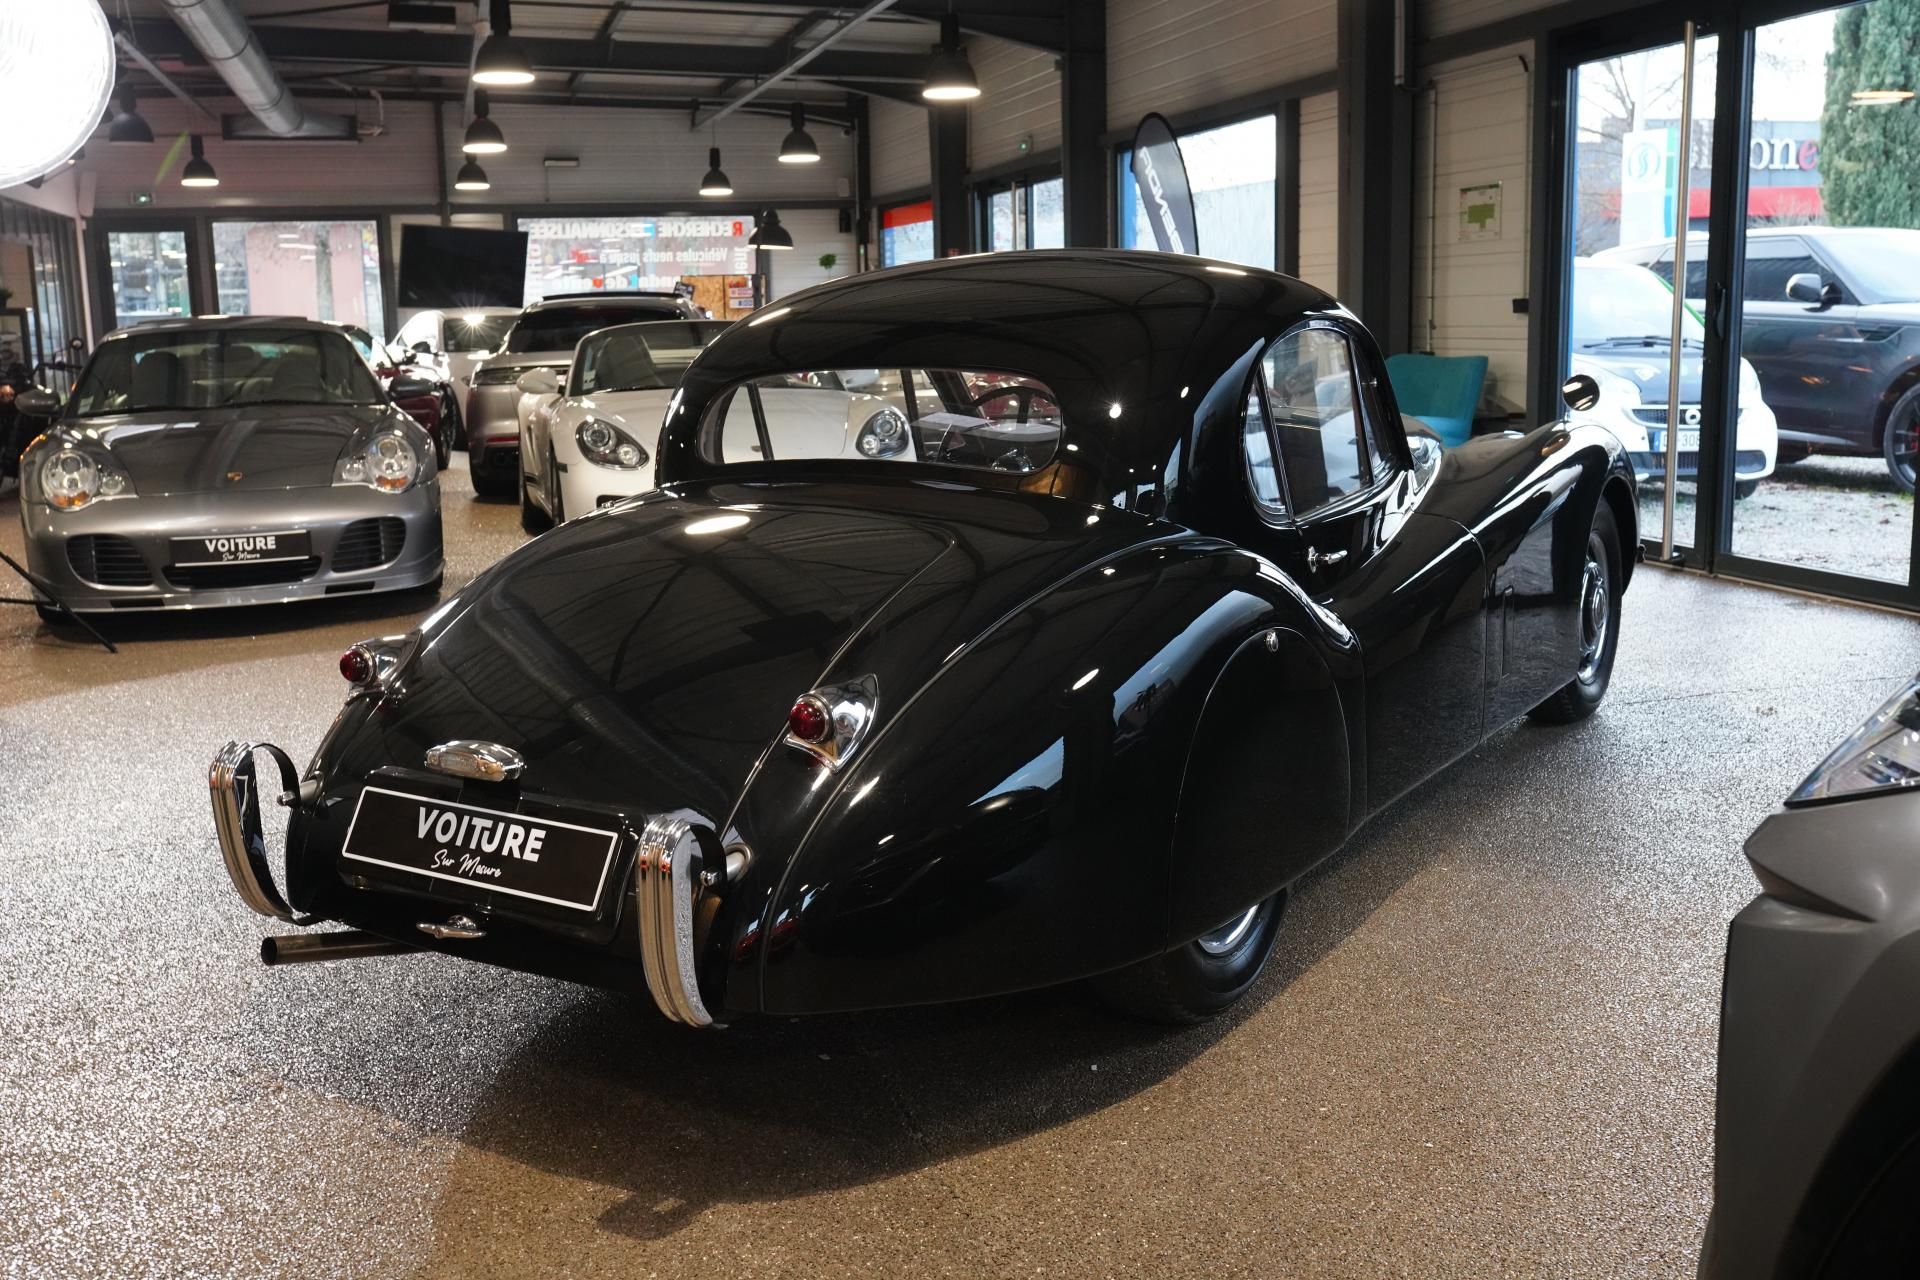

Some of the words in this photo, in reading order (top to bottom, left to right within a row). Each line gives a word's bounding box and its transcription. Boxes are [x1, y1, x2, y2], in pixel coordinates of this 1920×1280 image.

[205, 536, 276, 553] VOITURE
[417, 806, 546, 863] VOITURE
[430, 849, 455, 869] Sur
[459, 853, 502, 877] Mesure
